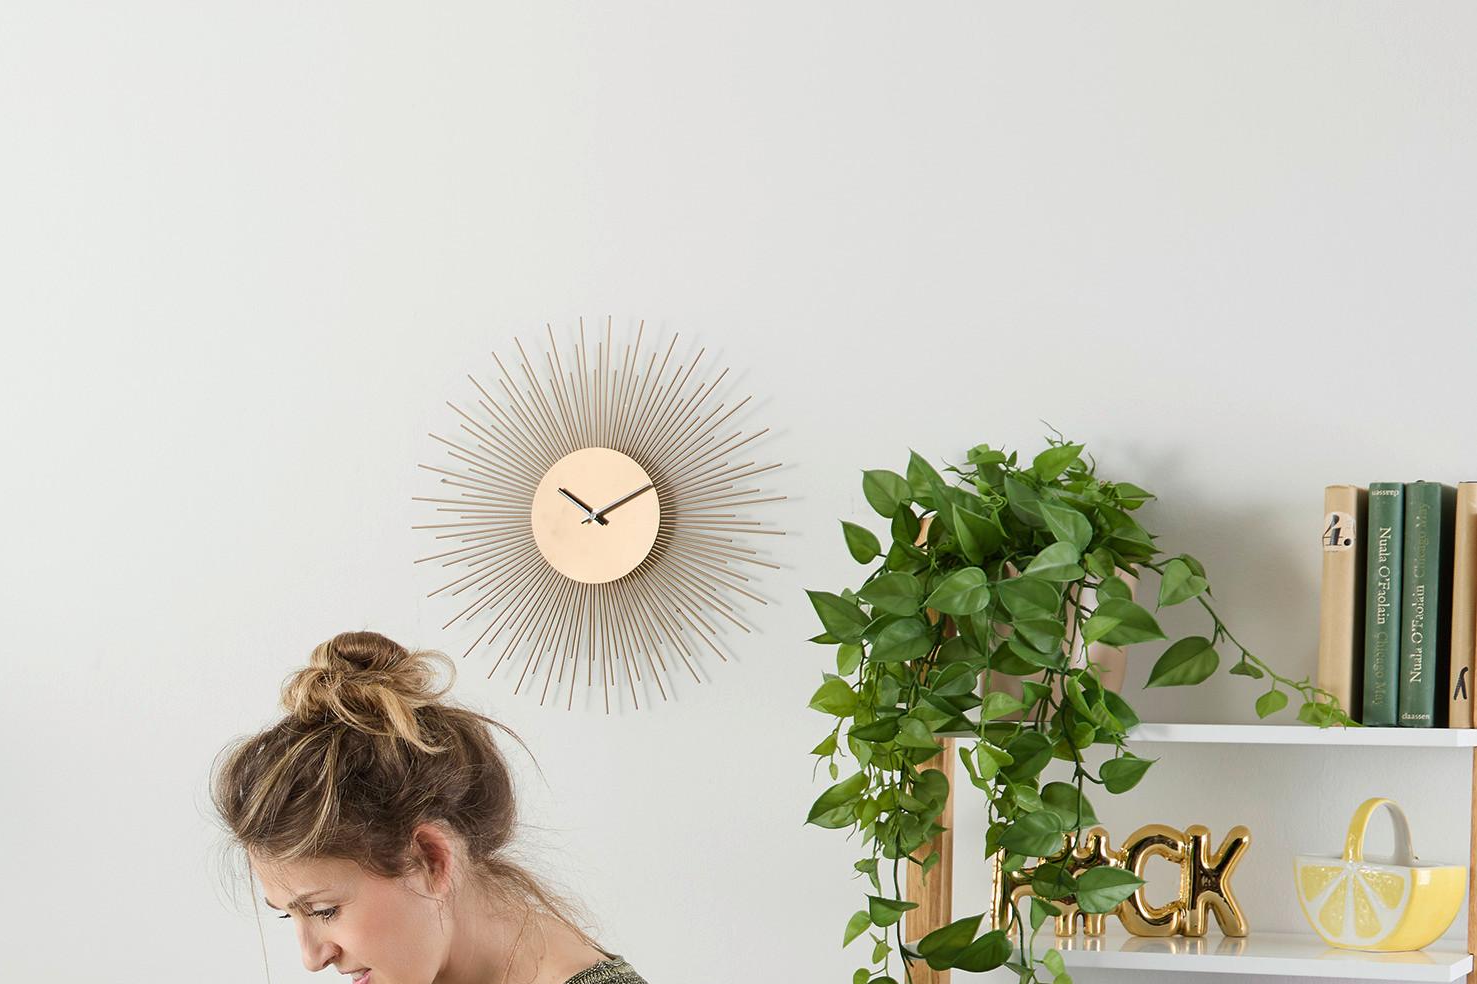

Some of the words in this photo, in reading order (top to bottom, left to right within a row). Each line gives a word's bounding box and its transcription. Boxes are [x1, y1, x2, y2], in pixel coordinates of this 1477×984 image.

[1379, 527, 1392, 563] Nuala
[1377, 565, 1391, 625] O'Faolain
[1410, 584, 1425, 647] O'Faolain
[1410, 649, 1422, 683] Nuala
